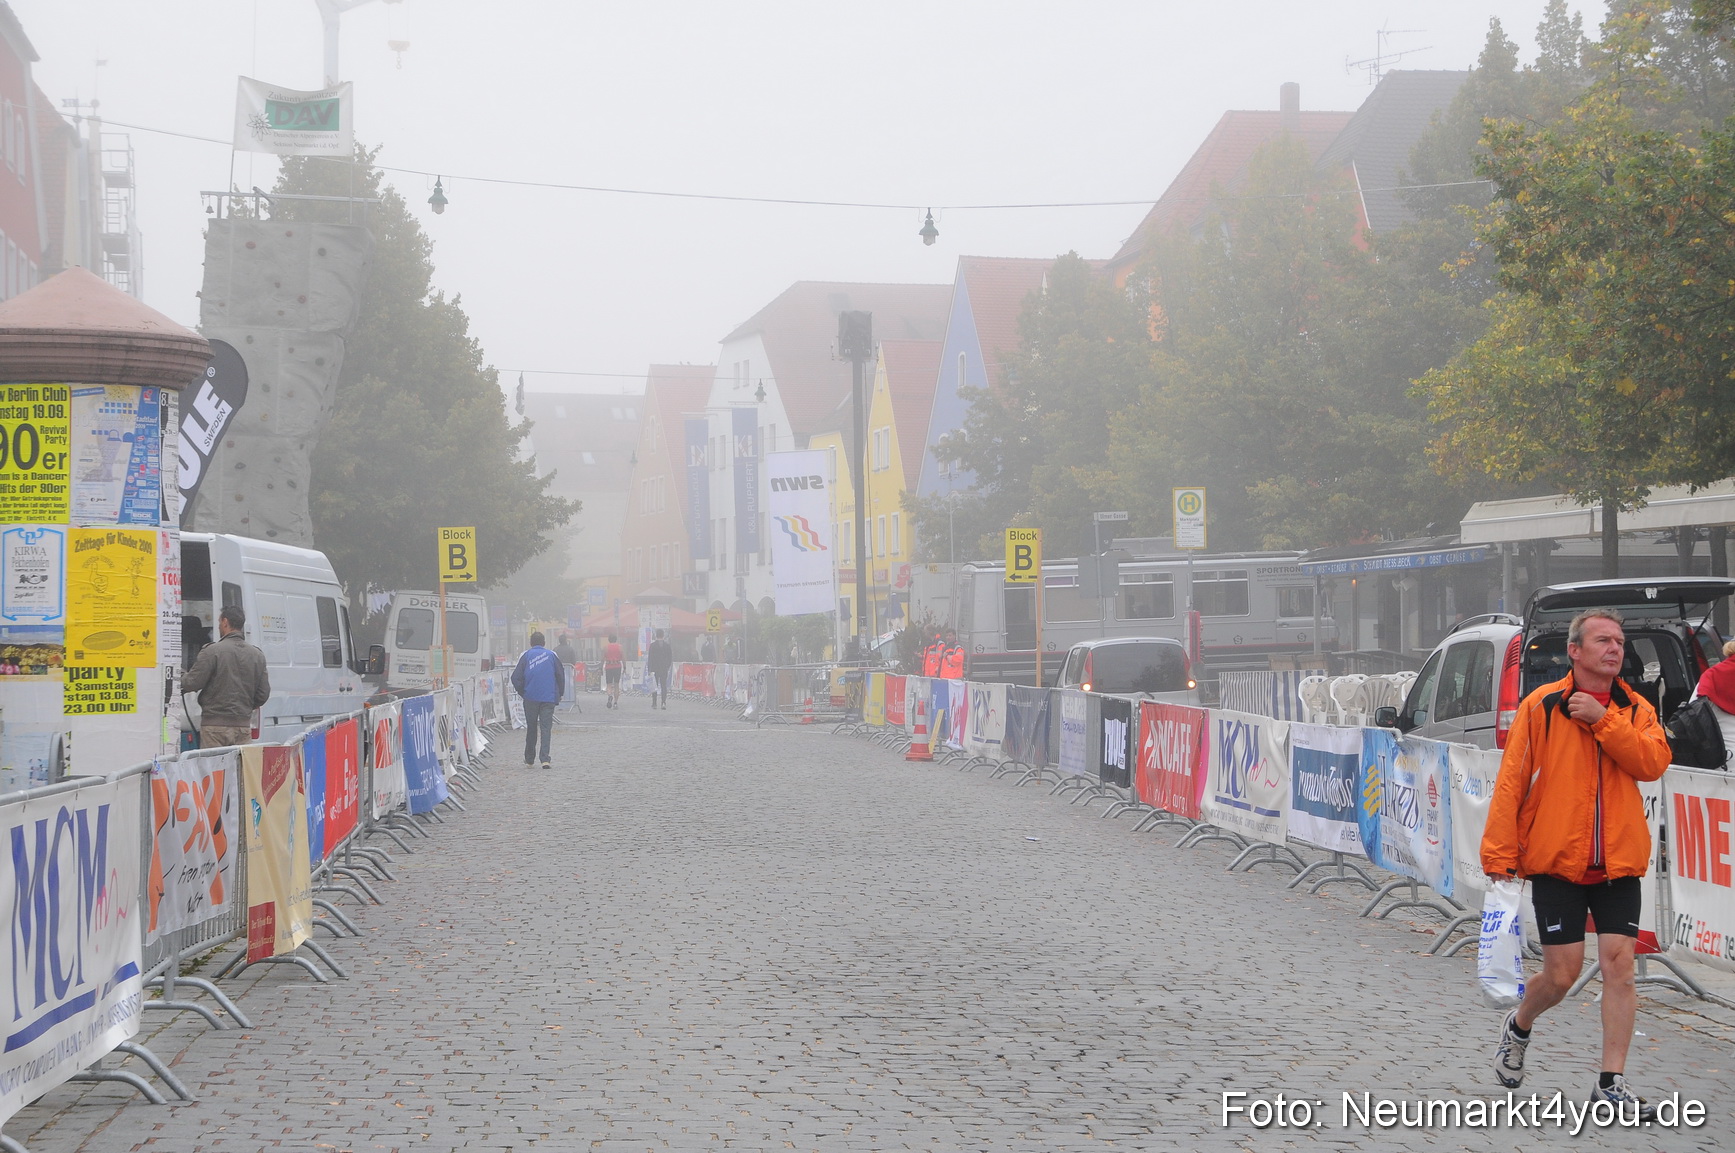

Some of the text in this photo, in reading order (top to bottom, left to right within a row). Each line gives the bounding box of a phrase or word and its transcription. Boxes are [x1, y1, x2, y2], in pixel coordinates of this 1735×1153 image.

[274, 102, 336, 126] DAV
[8, 387, 39, 402] Berlin
[42, 386, 67, 402] Club
[33, 404, 68, 419] 19.09.
[40, 425, 67, 445] Revival Party
[31, 472, 67, 480] Dancer
[19, 483, 37, 493] der
[40, 483, 67, 493] 90er
[745, 463, 756, 512] RUPPERT
[443, 529, 472, 540] Block
[1009, 530, 1038, 541] Block
[106, 531, 116, 546] für
[117, 531, 138, 549] Kinder
[138, 540, 153, 554] 2009
[14, 547, 47, 556] KIRWA
[449, 543, 468, 570] B
[1014, 544, 1033, 571] B
[409, 597, 470, 612] DÖRLER
[710, 615, 719, 628] C
[75, 681, 134, 692] Samstags
[99, 691, 132, 701] 13.08.
[64, 702, 134, 714] 23.00 Uhr
[1218, 719, 1260, 799] MCM
[10, 803, 111, 1023] MCM
[1693, 919, 1721, 957] Herz
